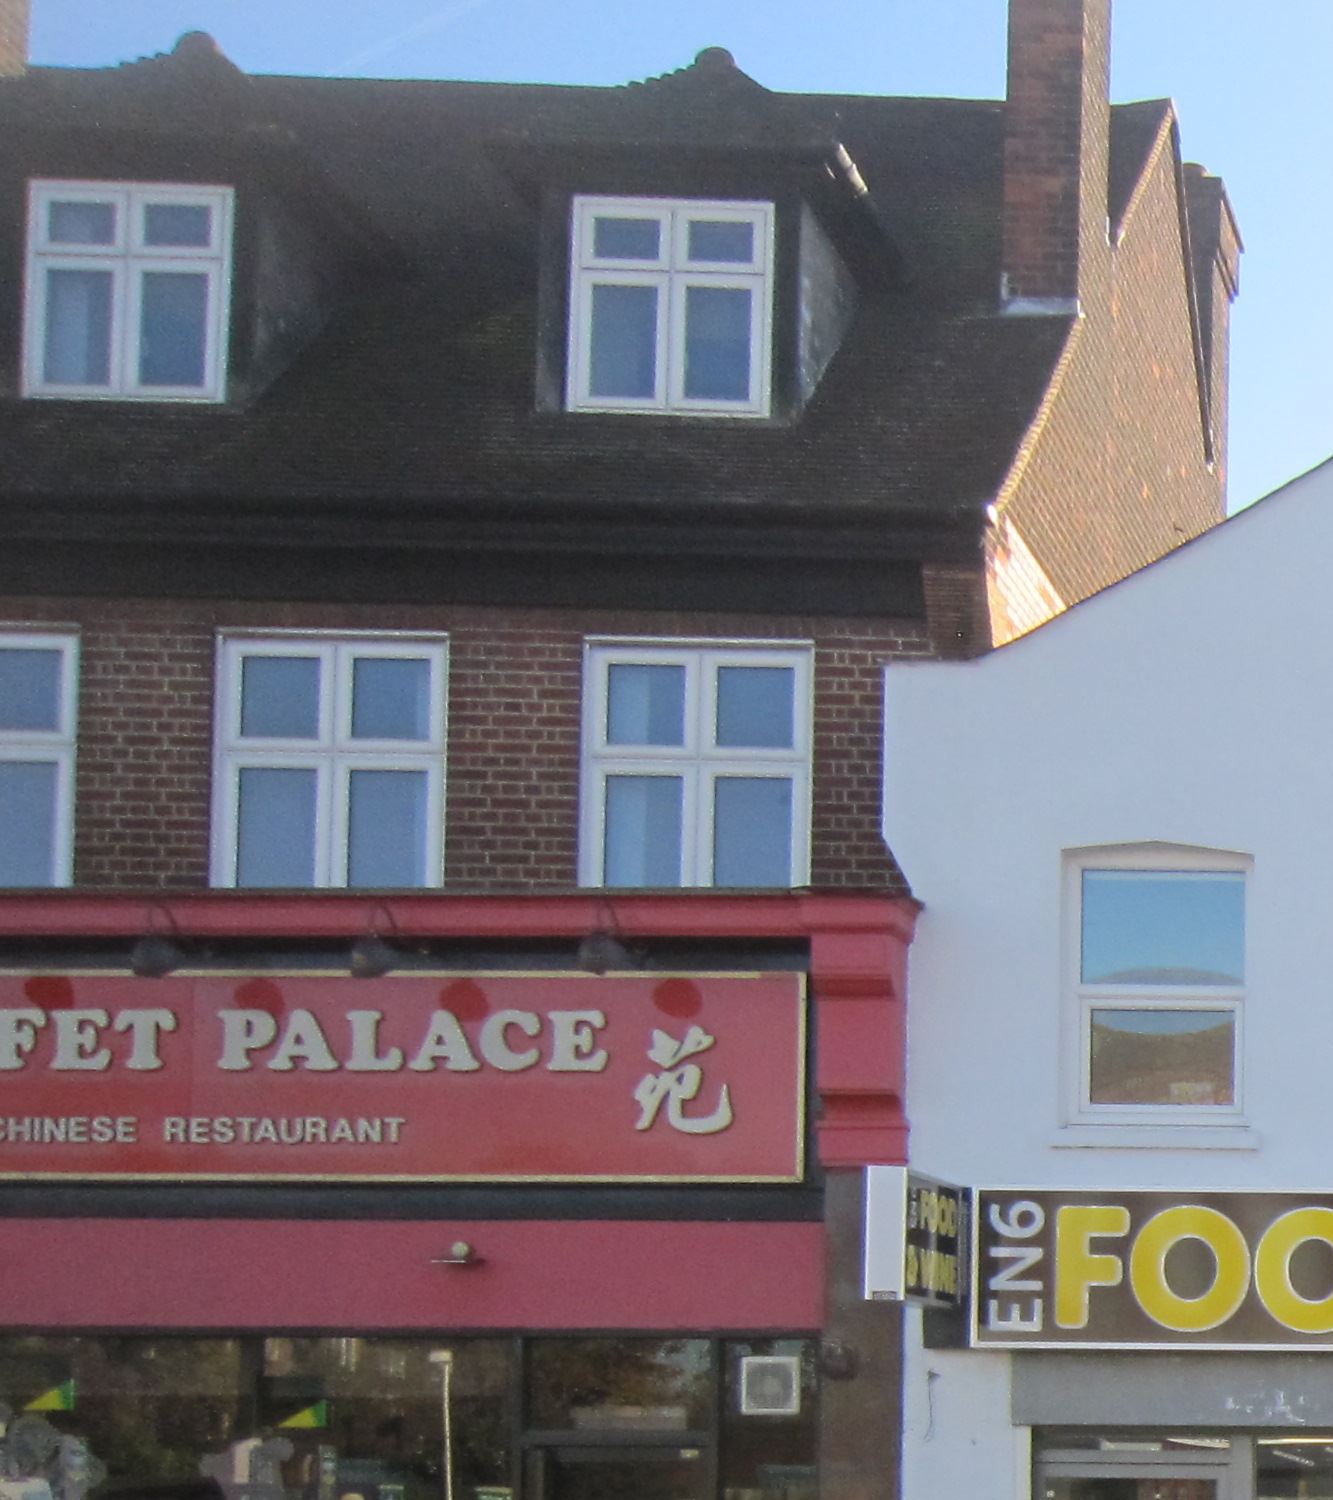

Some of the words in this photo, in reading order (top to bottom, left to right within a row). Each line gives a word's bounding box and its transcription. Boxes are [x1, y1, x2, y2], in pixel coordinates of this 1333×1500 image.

[216, 1008, 609, 1073] PALACE
[0, 1115, 138, 1144] HINESE
[163, 1116, 406, 1146] RESTAURANT
[989, 1200, 1046, 1332] EN6
